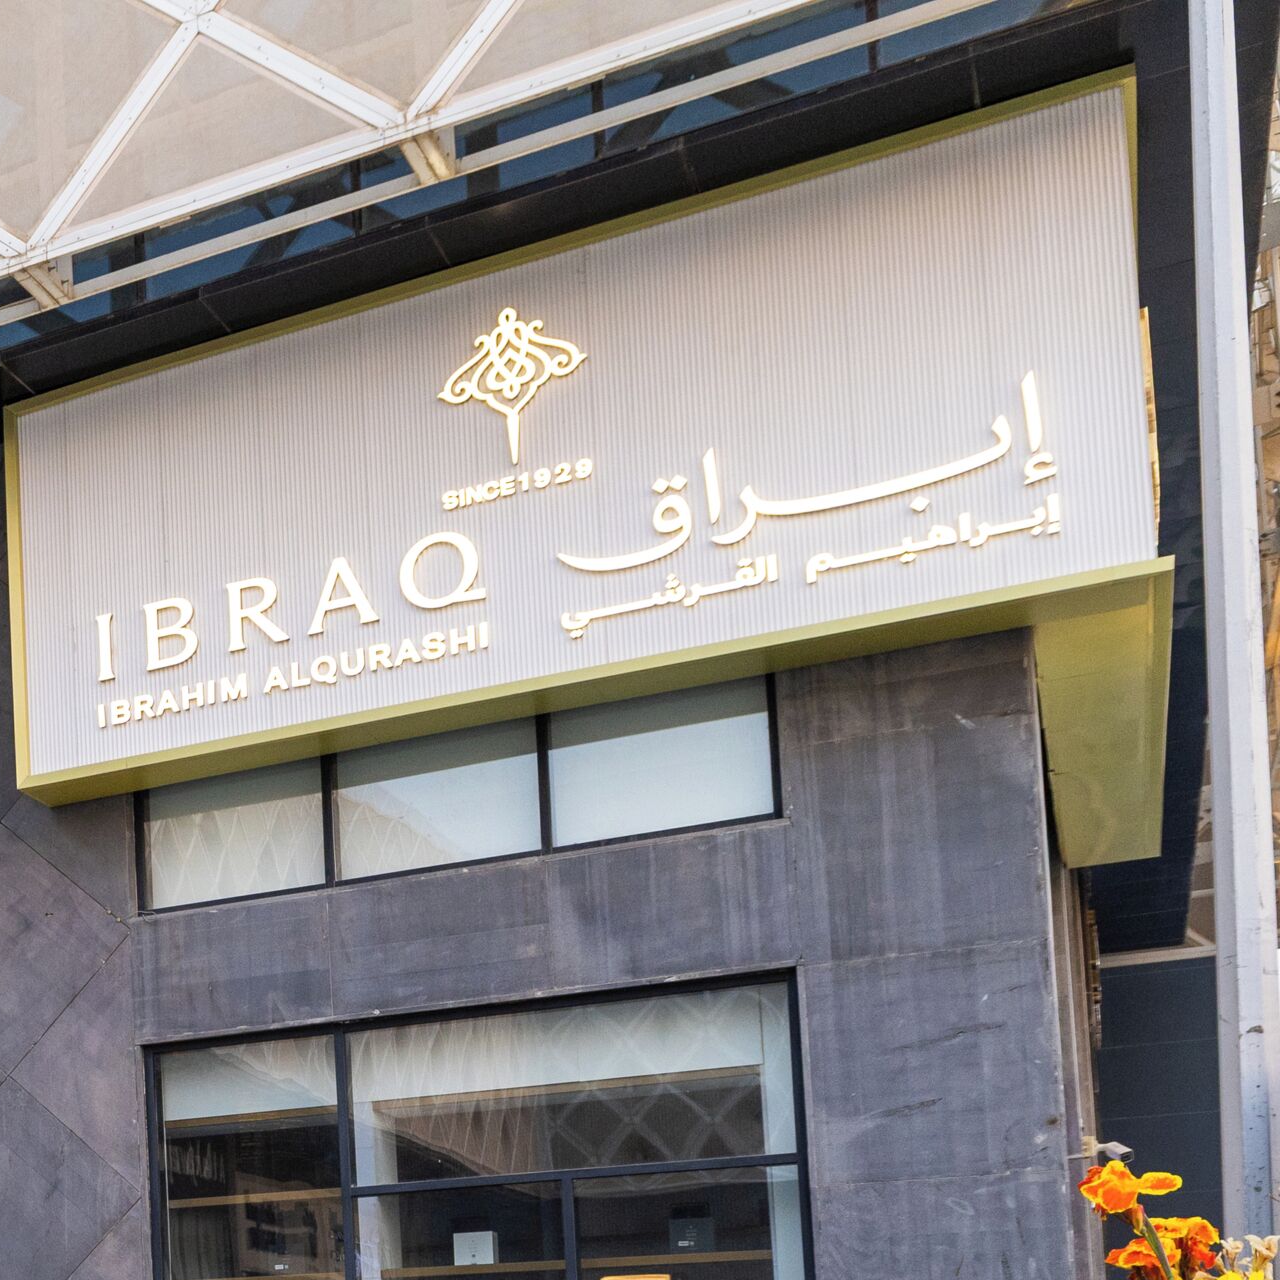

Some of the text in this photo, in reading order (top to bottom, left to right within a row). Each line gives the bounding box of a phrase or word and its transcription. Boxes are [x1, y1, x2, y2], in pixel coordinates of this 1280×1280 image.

[95, 530, 487, 682] IBRAQ
[97, 621, 490, 729] IBRAHIM ALQURASHI
